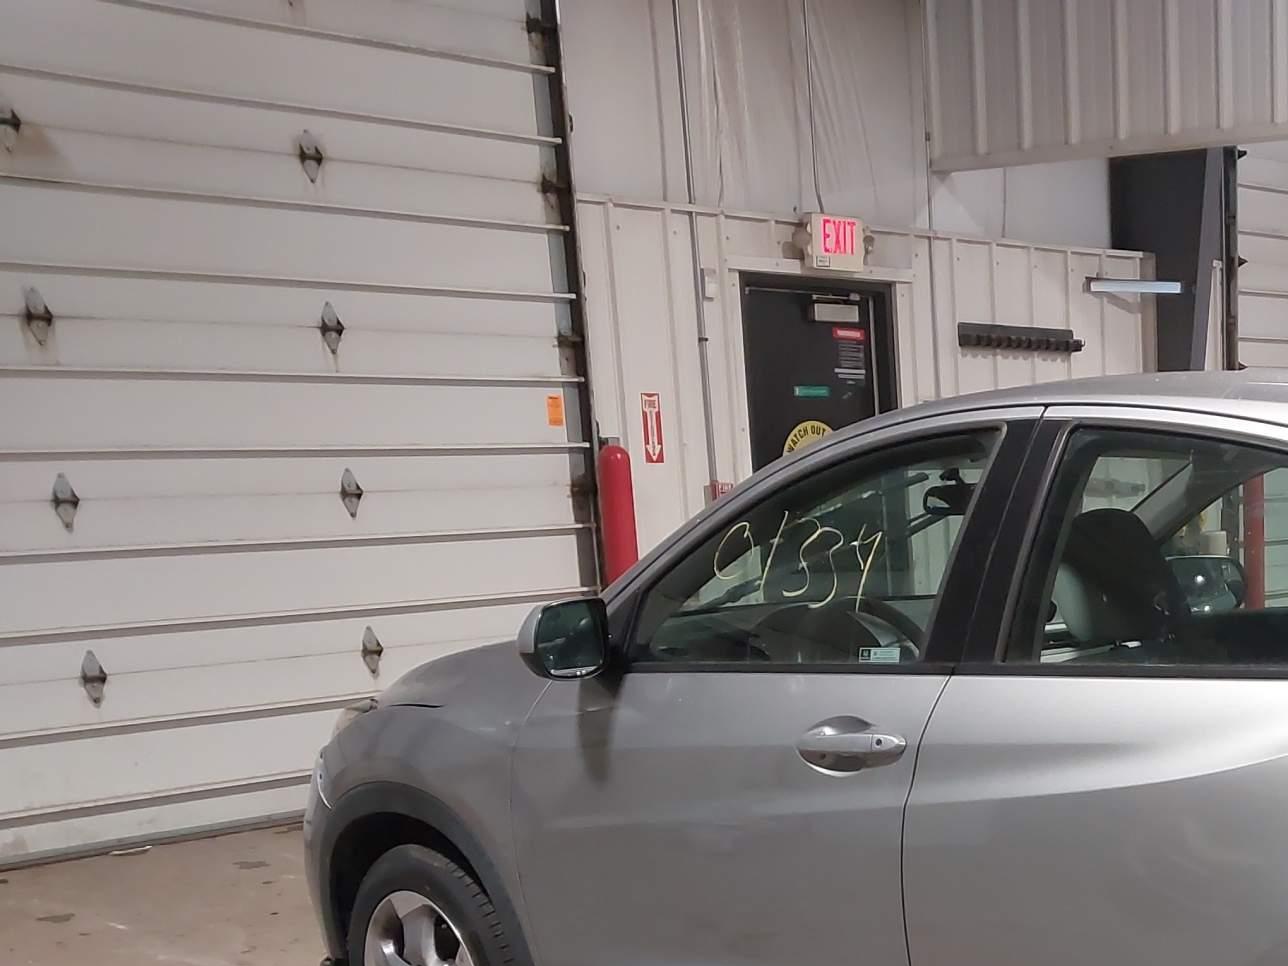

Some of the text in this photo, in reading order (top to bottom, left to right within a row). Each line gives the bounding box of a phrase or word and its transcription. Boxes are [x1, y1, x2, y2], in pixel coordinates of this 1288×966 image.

[822, 218, 856, 255] EXIT
[786, 425, 827, 453] WATCH OUT
